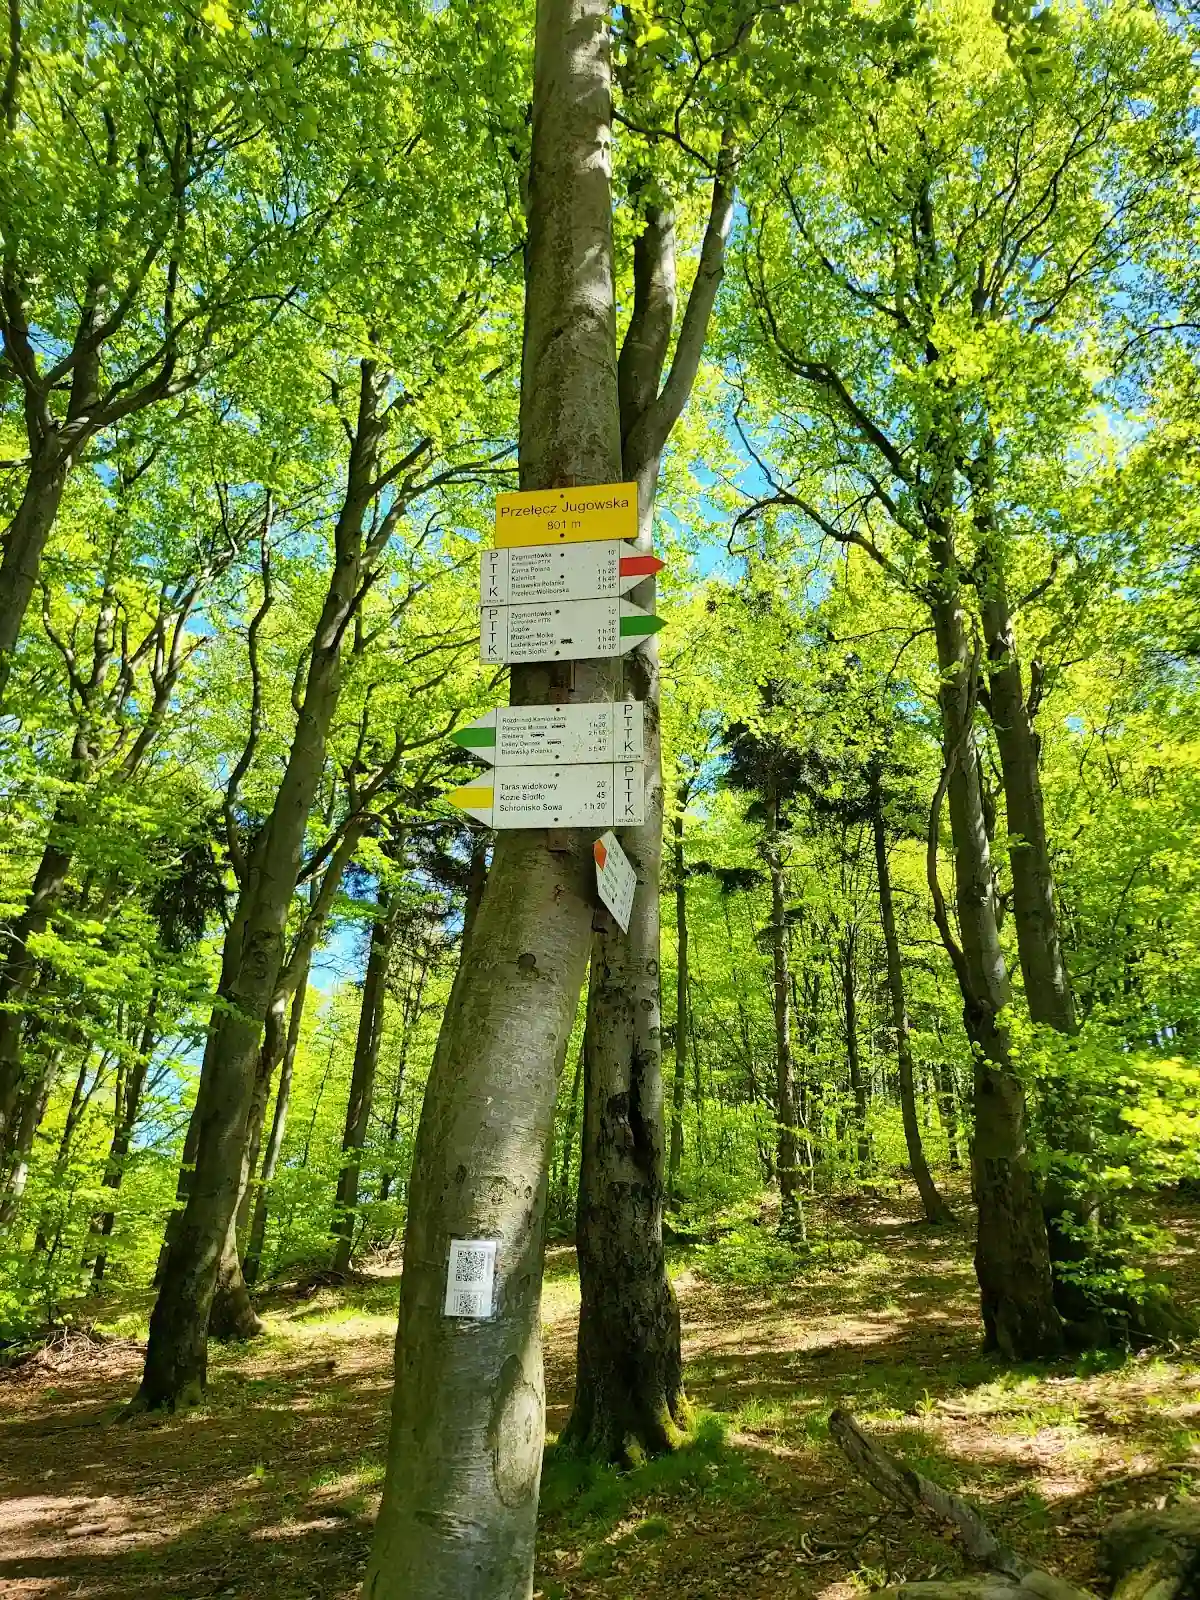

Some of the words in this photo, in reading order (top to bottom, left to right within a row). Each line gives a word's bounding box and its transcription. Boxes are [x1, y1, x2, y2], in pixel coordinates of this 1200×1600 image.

[501, 504, 557, 518] Przełęcz
[561, 497, 629, 514] Jugowska
[547, 520, 567, 530] 801
[571, 520, 581, 528] m
[522, 782, 558, 790] widokowy
[522, 793, 545, 801] Siodło
[500, 804, 540, 812] Schronisko
[542, 803, 563, 811] Sowa
